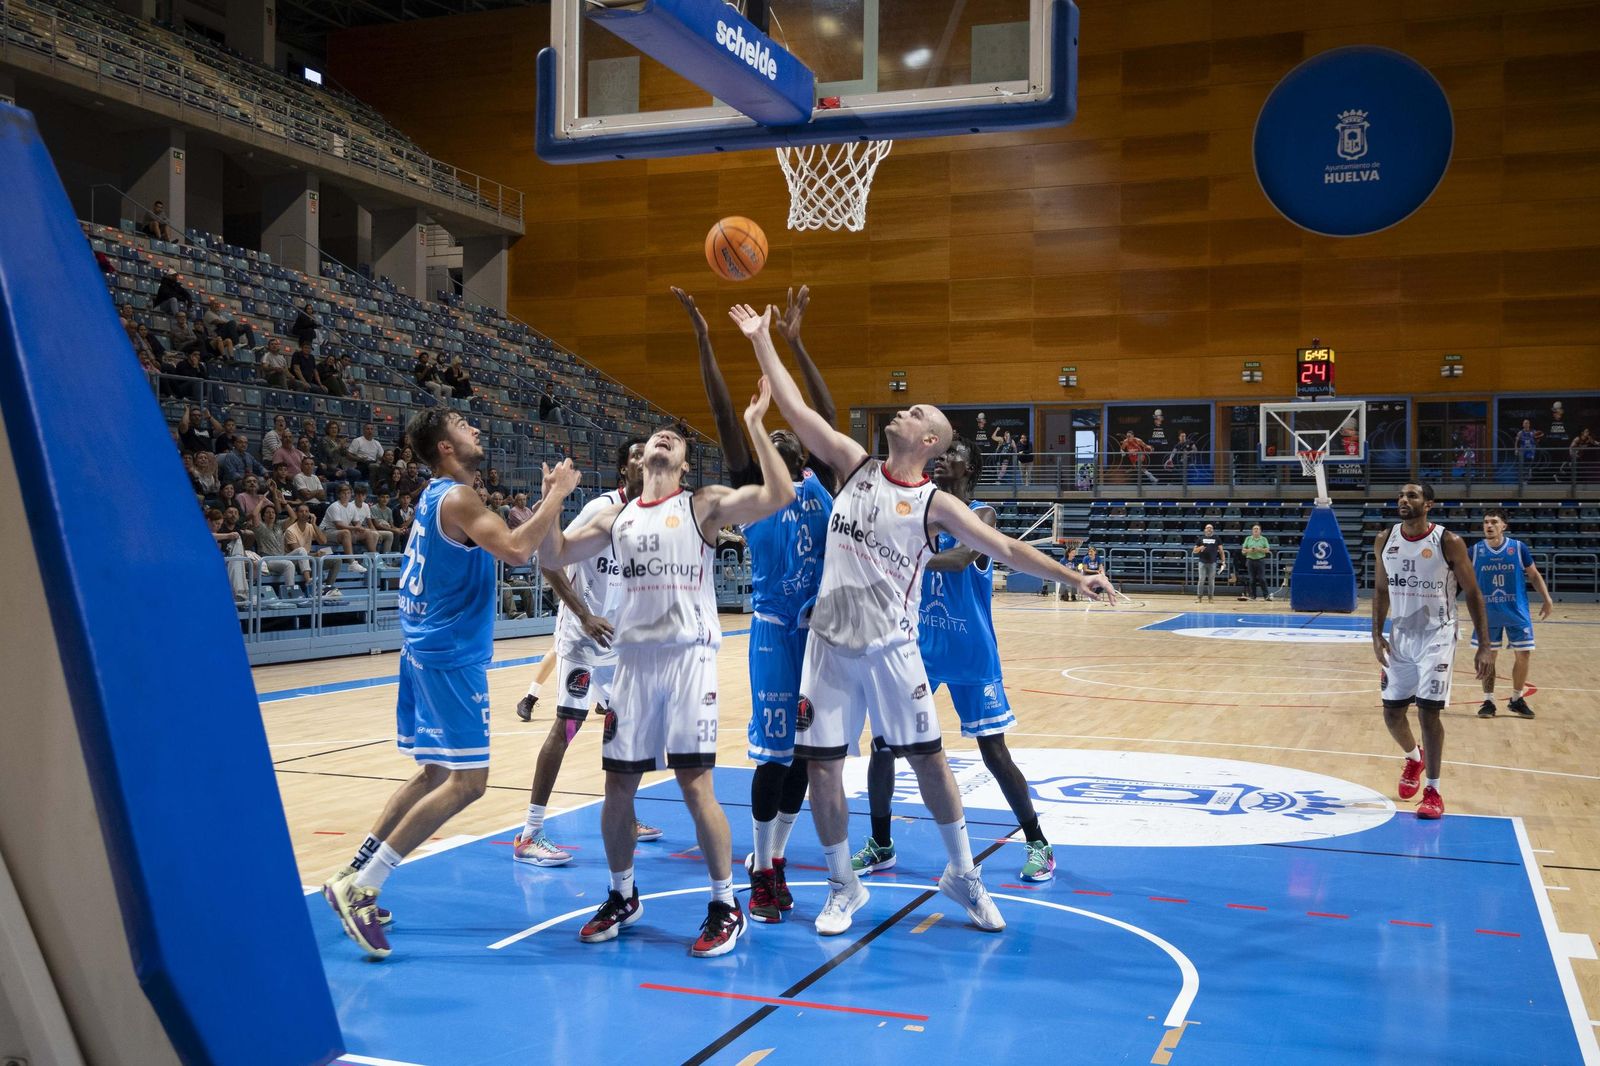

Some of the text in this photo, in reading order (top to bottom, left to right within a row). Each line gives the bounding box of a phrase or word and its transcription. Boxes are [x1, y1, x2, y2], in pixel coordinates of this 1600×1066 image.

[715, 20, 777, 80] schelde
[1324, 169, 1380, 184] HUELVA
[1325, 162, 1371, 172] Ayuntamiento
[1304, 349, 1328, 361] 6:45
[1301, 363, 1326, 382] 24
[636, 533, 660, 553] 33
[831, 513, 911, 571] BieleGroup
[399, 520, 426, 596] 55
[1402, 559, 1416, 573] 31
[622, 558, 699, 582] eleGroup
[1492, 574, 1505, 587] 40
[930, 571, 945, 597] 12
[918, 613, 969, 634] MERITA
[697, 719, 717, 743] 33
[763, 707, 787, 738] 23
[915, 711, 929, 734] 8
[350, 837, 381, 871] ELITE
